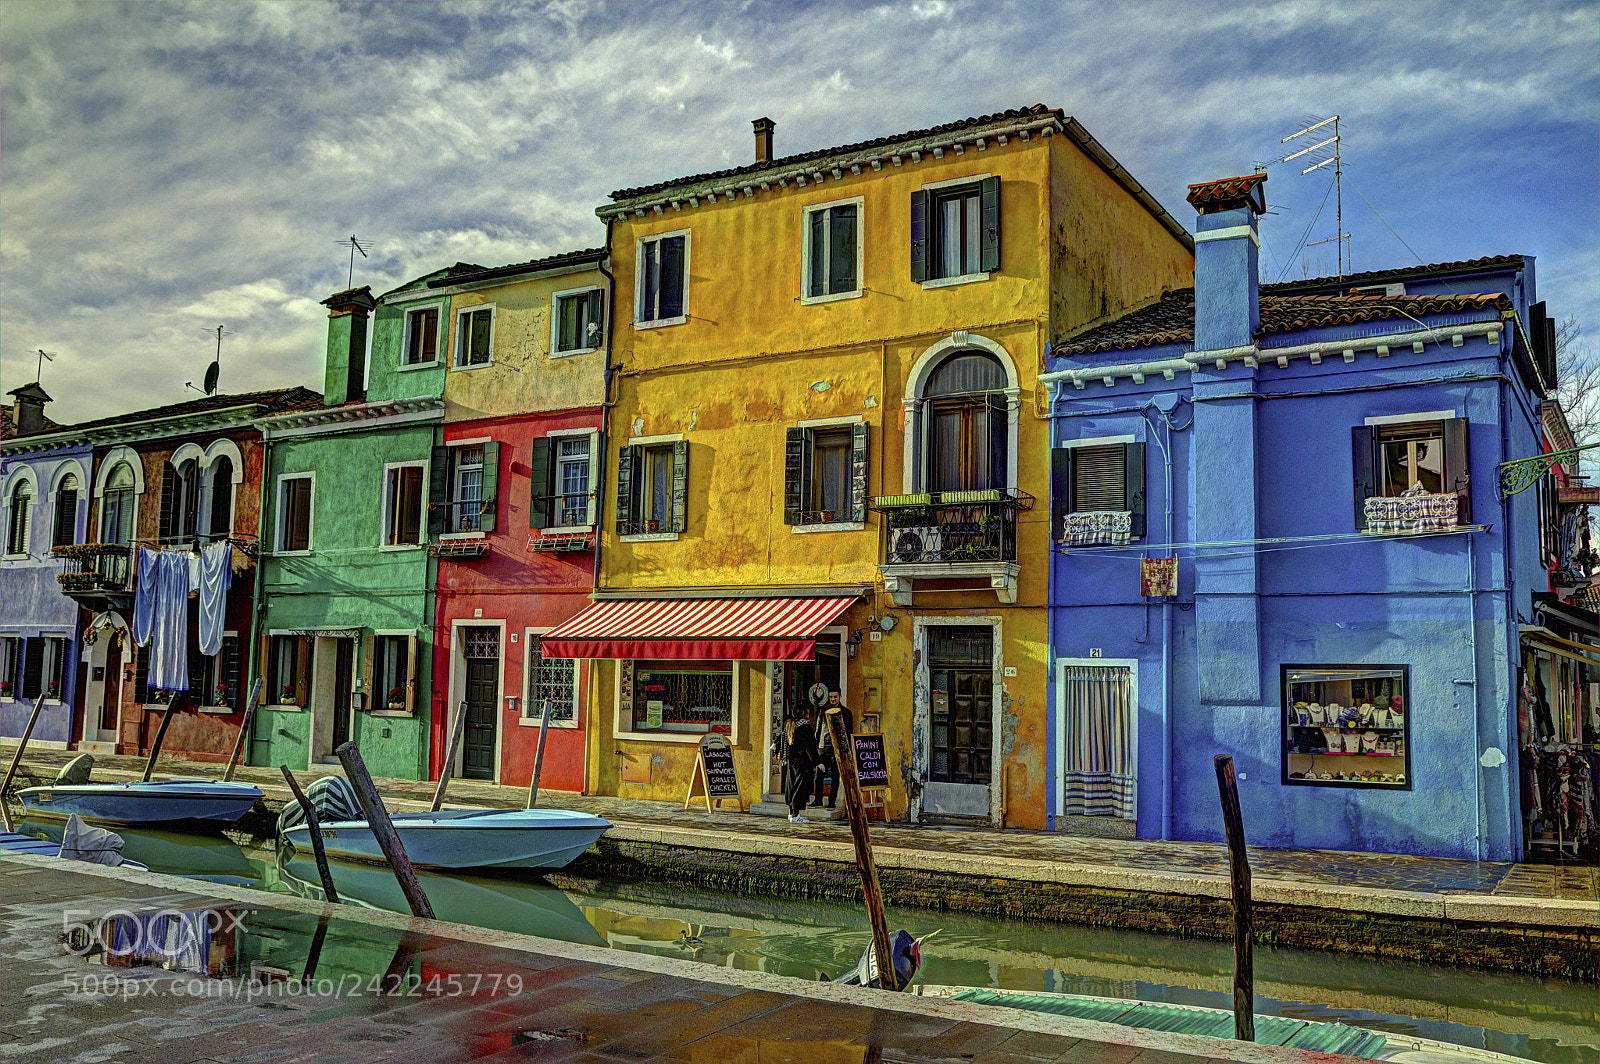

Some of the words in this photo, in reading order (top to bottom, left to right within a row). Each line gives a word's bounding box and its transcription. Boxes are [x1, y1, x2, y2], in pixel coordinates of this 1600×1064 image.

[1091, 648, 1100, 657] 21
[862, 760, 878, 769] CON
[709, 784, 737, 792] CHICKEN
